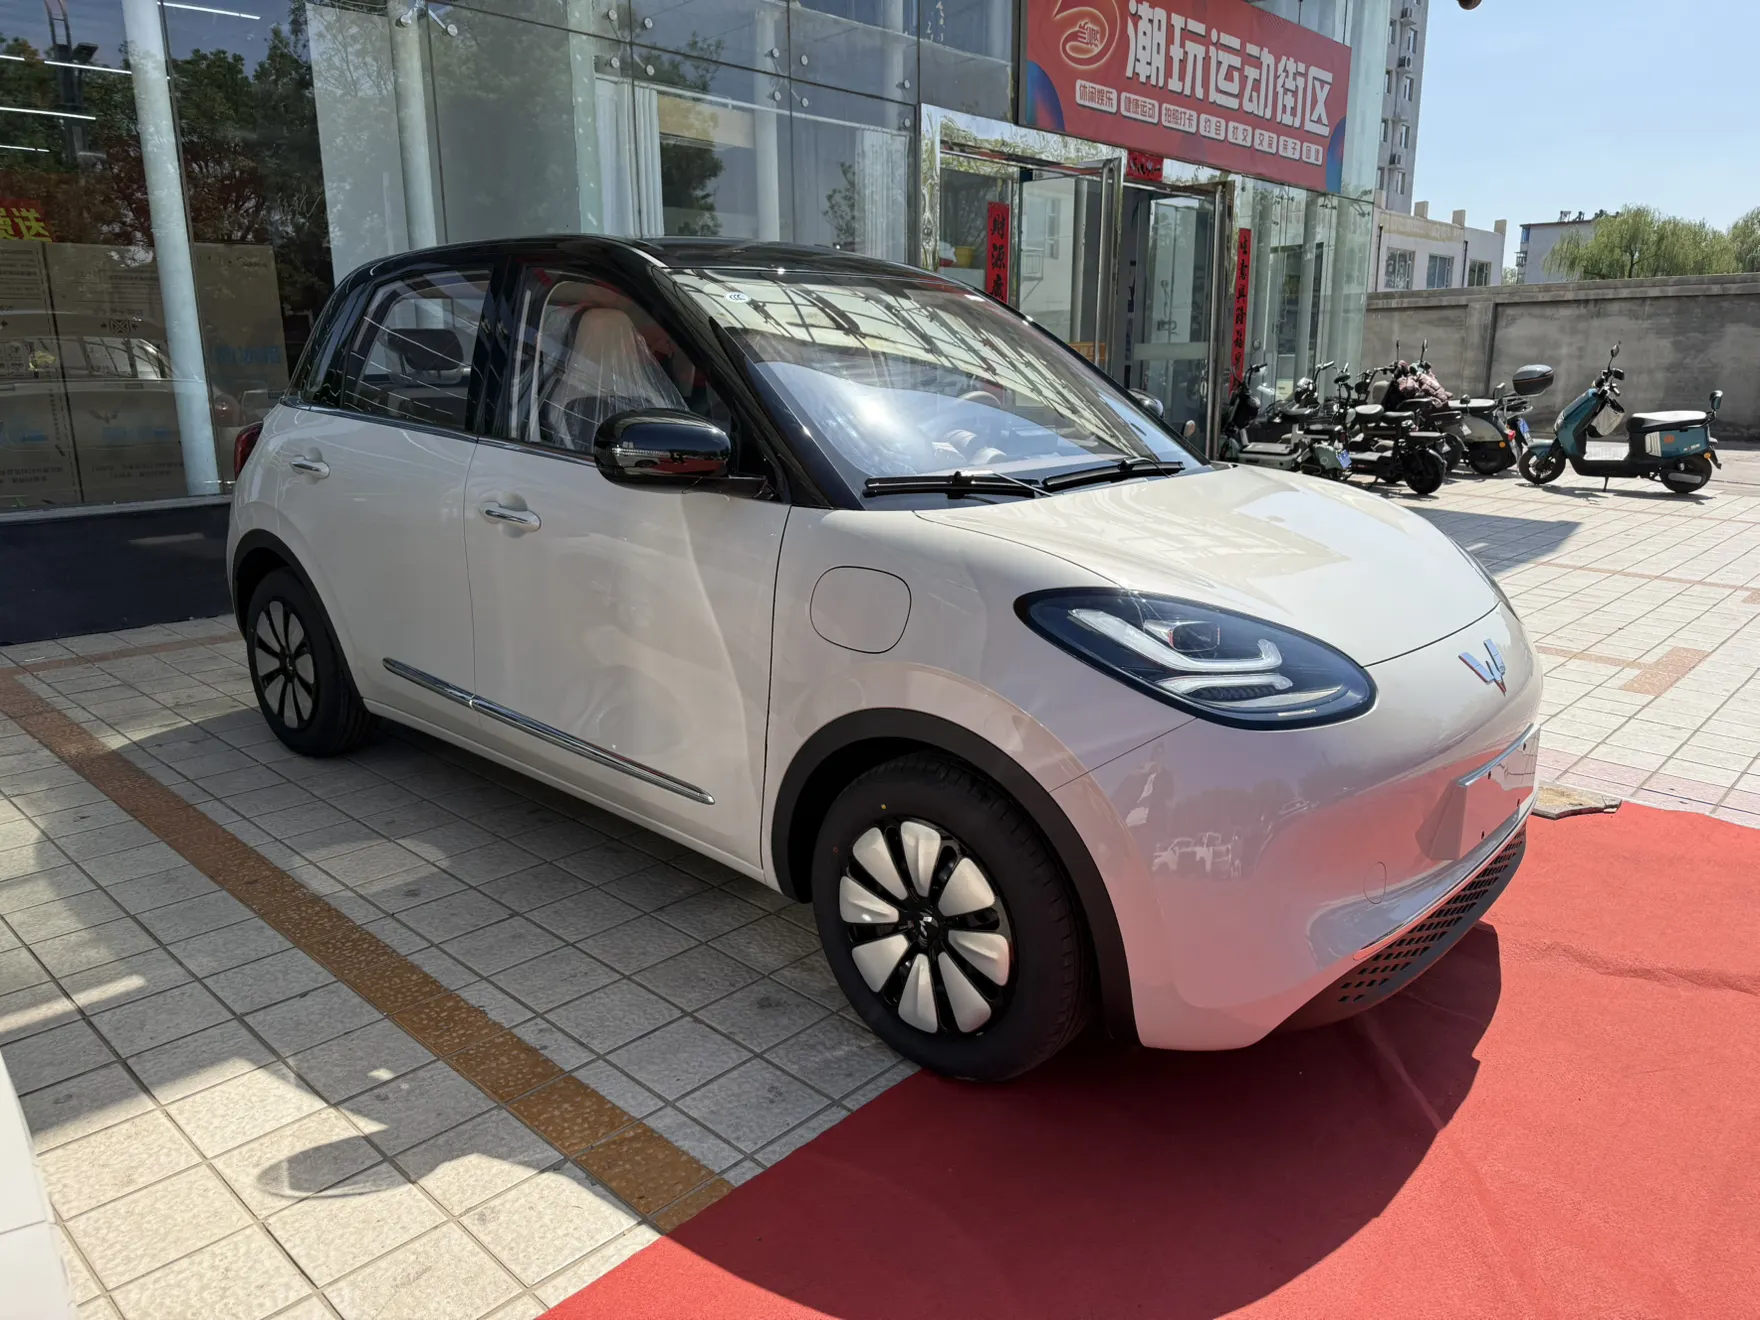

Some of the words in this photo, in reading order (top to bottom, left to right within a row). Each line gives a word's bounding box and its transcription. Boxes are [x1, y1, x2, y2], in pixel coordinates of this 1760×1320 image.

[1079, 83, 1114, 109] 休闲娱乐
[1123, 94, 1156, 120] 健康运动
[1164, 106, 1195, 129] 拍照打卡
[1203, 116, 1222, 137] 约会
[1231, 124, 1249, 144] 社交
[1282, 139, 1298, 156] 亲子
[1126, 0, 1333, 136] 潮玩运动街区
